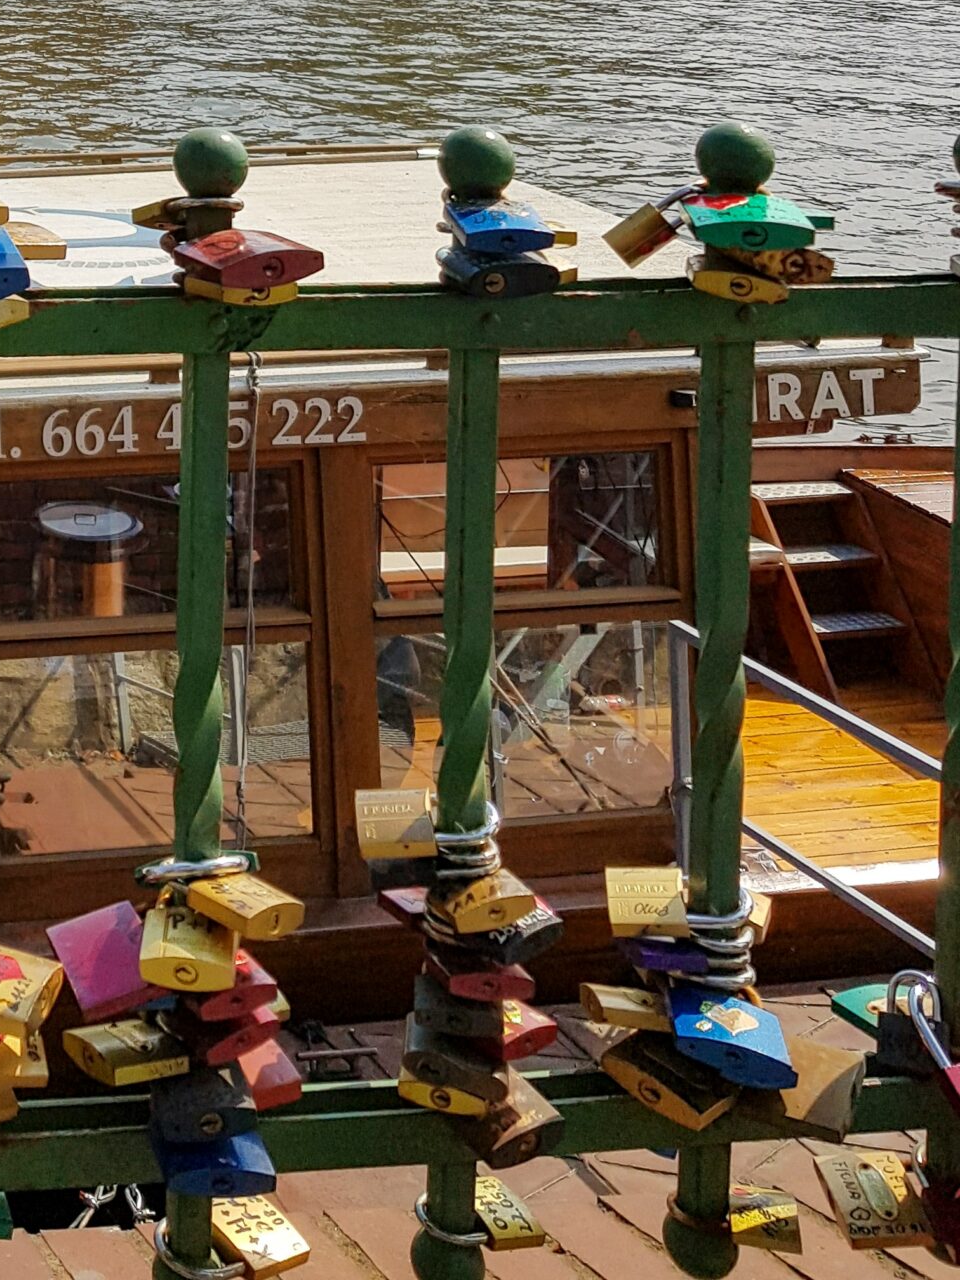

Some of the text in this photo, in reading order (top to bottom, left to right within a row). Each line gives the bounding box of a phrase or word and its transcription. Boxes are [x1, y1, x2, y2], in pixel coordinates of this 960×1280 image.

[41, 405, 139, 459] 664
[156, 400, 253, 452] 45
[271, 395, 368, 446] 222
